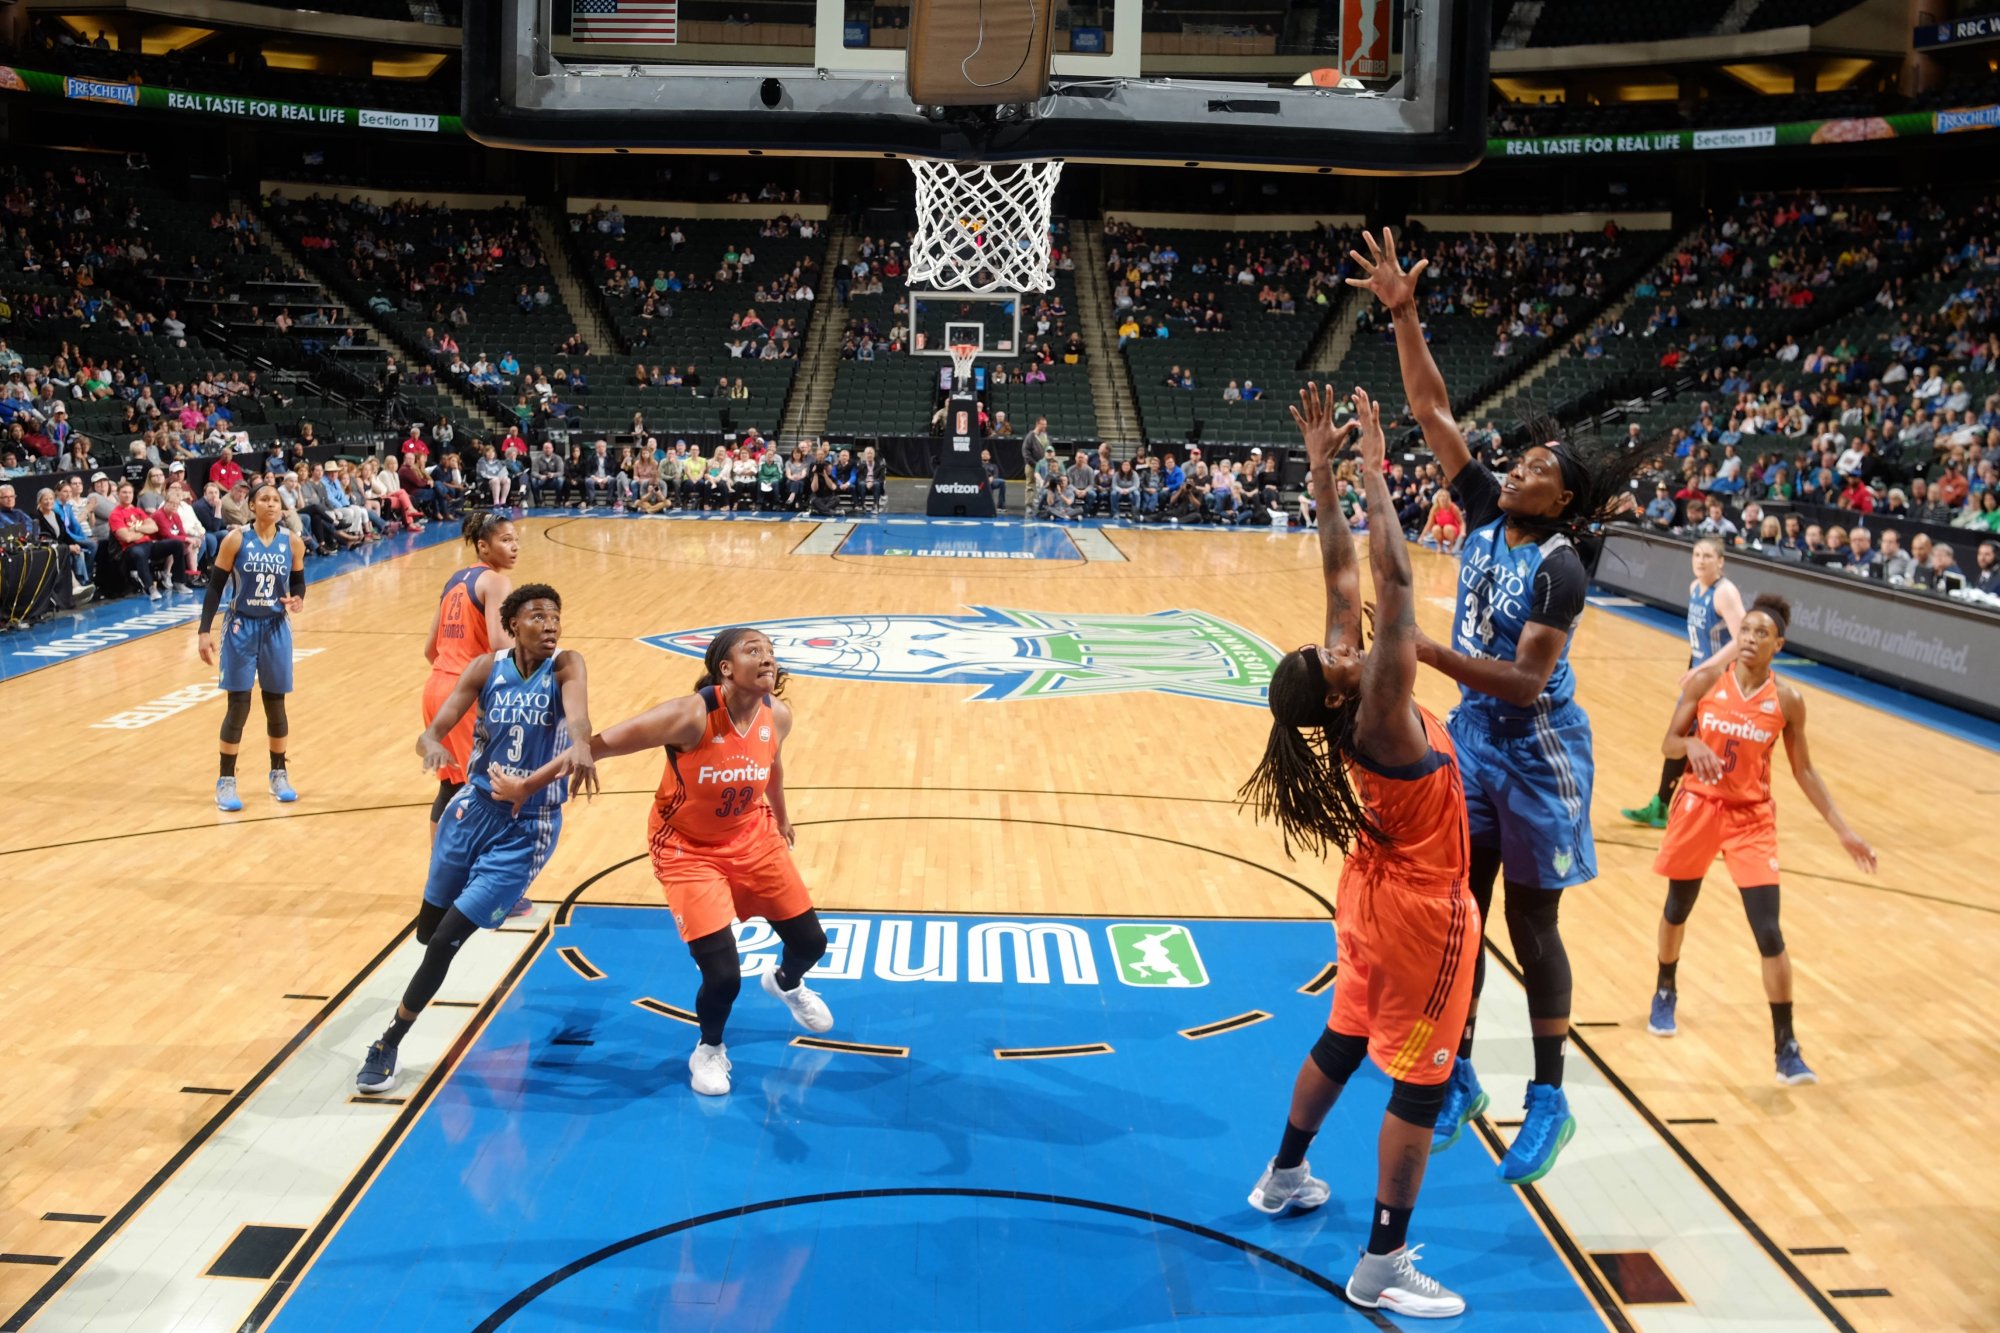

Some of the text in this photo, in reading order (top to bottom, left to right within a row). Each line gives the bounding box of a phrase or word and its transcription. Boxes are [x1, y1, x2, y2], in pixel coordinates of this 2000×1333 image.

[1957, 20, 1986, 38] RBC
[67, 79, 135, 103] FRESCHETTA
[168, 93, 345, 123] REAL TASTE FOR REAL LIFE
[361, 112, 436, 129] Section 117
[1506, 134, 1681, 155] REAL TASTE FOR REAL LIFE
[1695, 131, 1773, 148] Section 117
[935, 482, 979, 494] verizon
[243, 562, 288, 576] CLINIC
[247, 551, 286, 565] MAYO
[1469, 546, 1524, 597] MAYO
[254, 572, 276, 598] 23
[1461, 564, 1522, 619] CLINIC
[447, 592, 464, 621] 25
[1461, 592, 1495, 646] 34
[441, 623, 465, 639] THOMAS
[1823, 608, 1882, 649] Verizon
[1881, 628, 1969, 675] unlimited.
[1202, 620, 1272, 684] MINNESOTA
[493, 690, 551, 709] MAYO
[488, 707, 554, 726] CLINIC
[1701, 711, 1773, 744] Frontier
[506, 724, 525, 763] 3
[1722, 738, 1740, 774] 5
[697, 764, 770, 785] Frontier
[715, 785, 755, 818] 33
